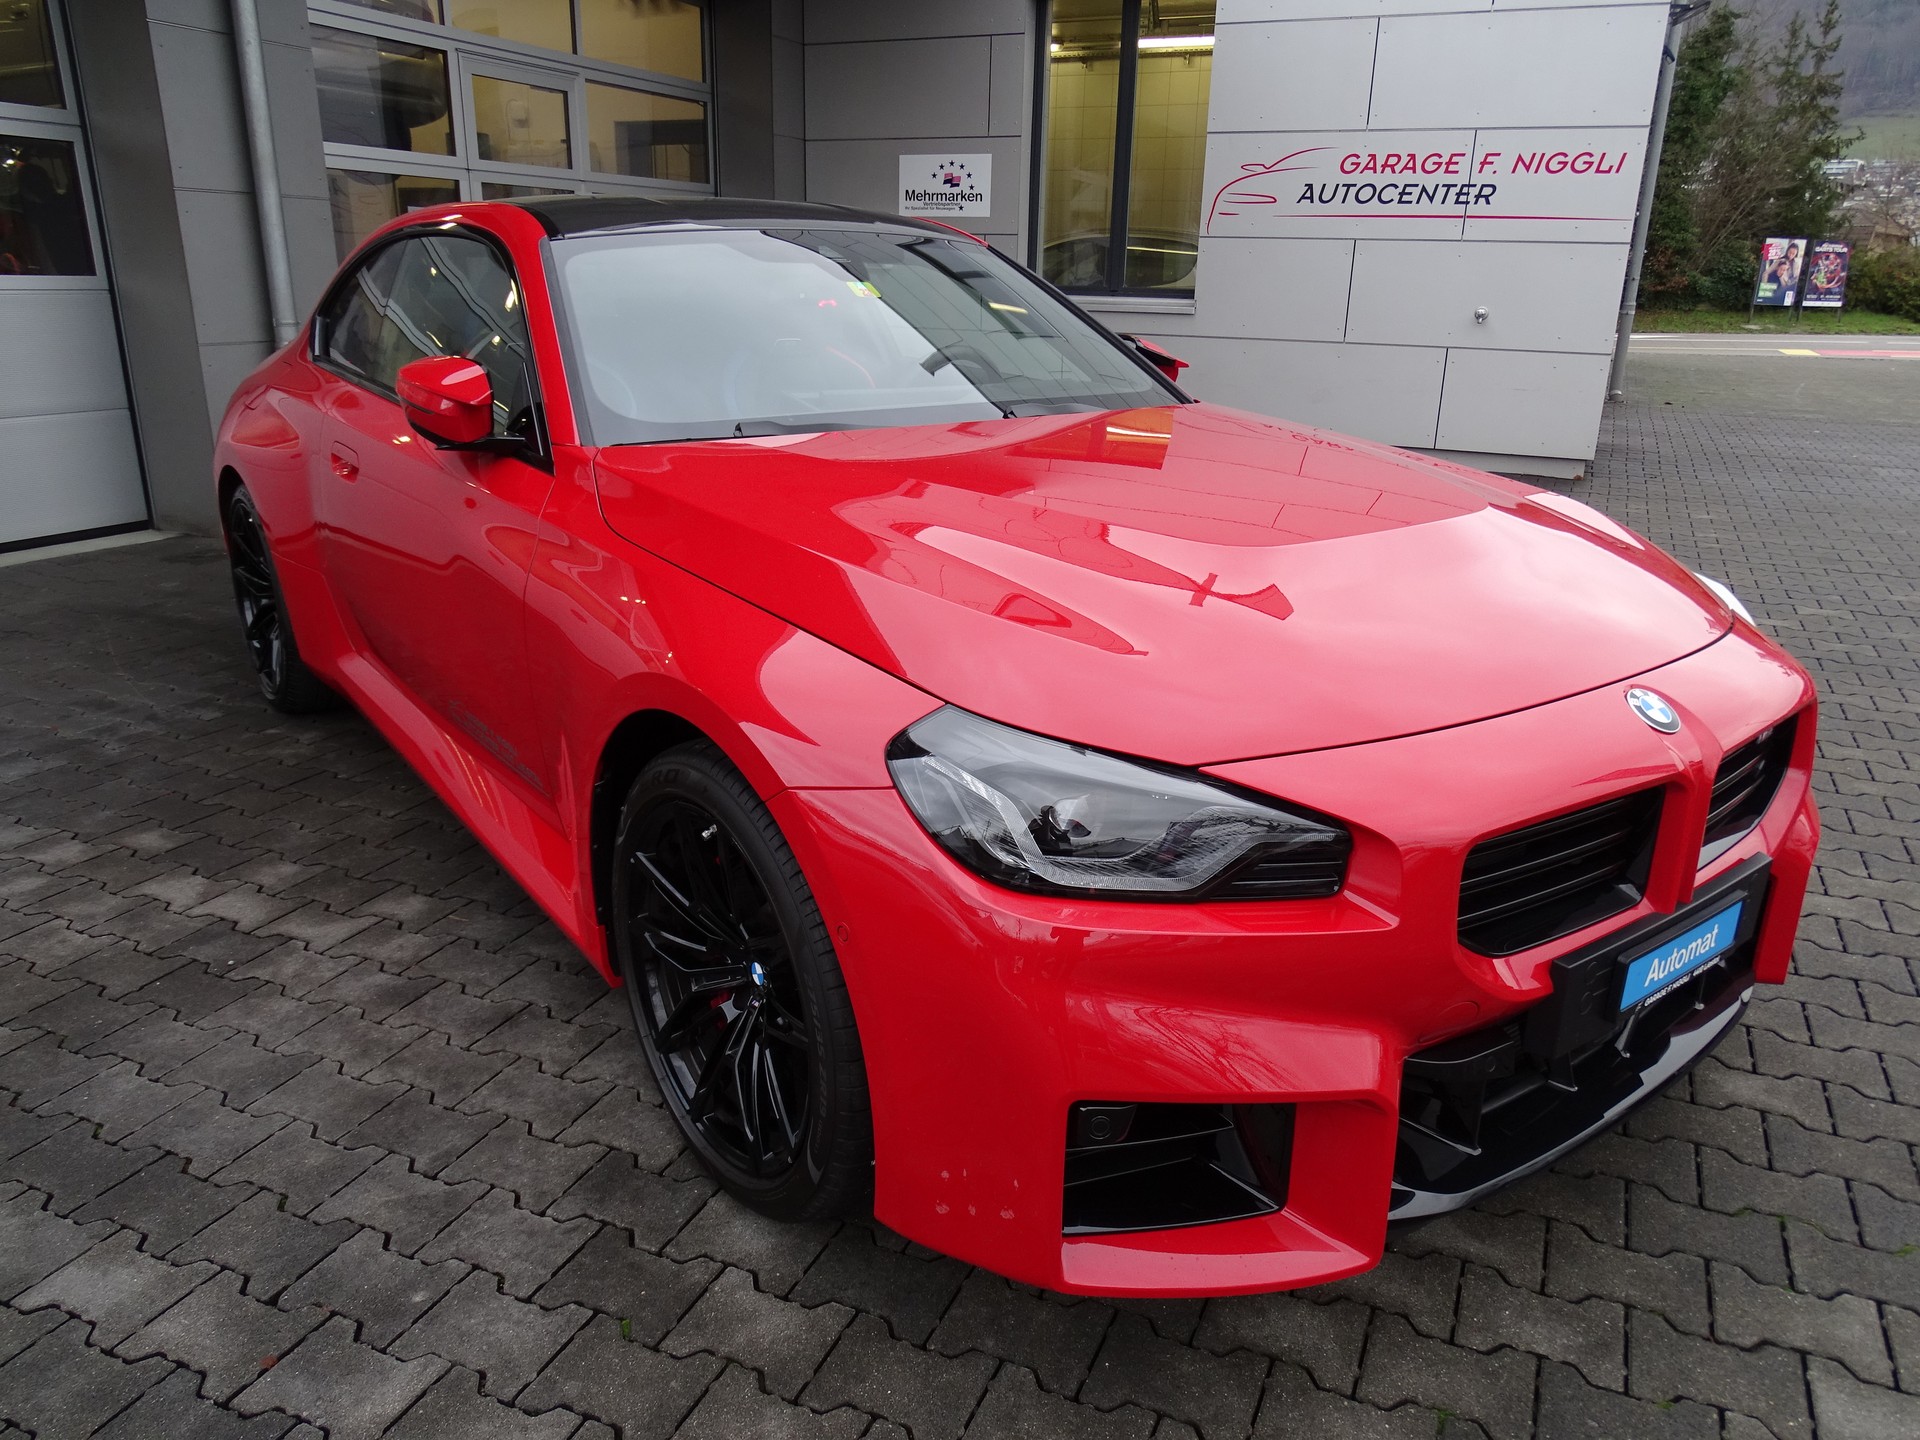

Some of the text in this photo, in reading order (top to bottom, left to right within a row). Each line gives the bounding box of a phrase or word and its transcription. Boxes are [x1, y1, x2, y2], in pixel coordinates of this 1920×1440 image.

[1339, 151, 1628, 175] GARAGE F. NIGGLI
[905, 189, 983, 202] Mehrmarken
[1296, 183, 1497, 206] AUTOCENTER
[1643, 923, 1719, 988] Automat
